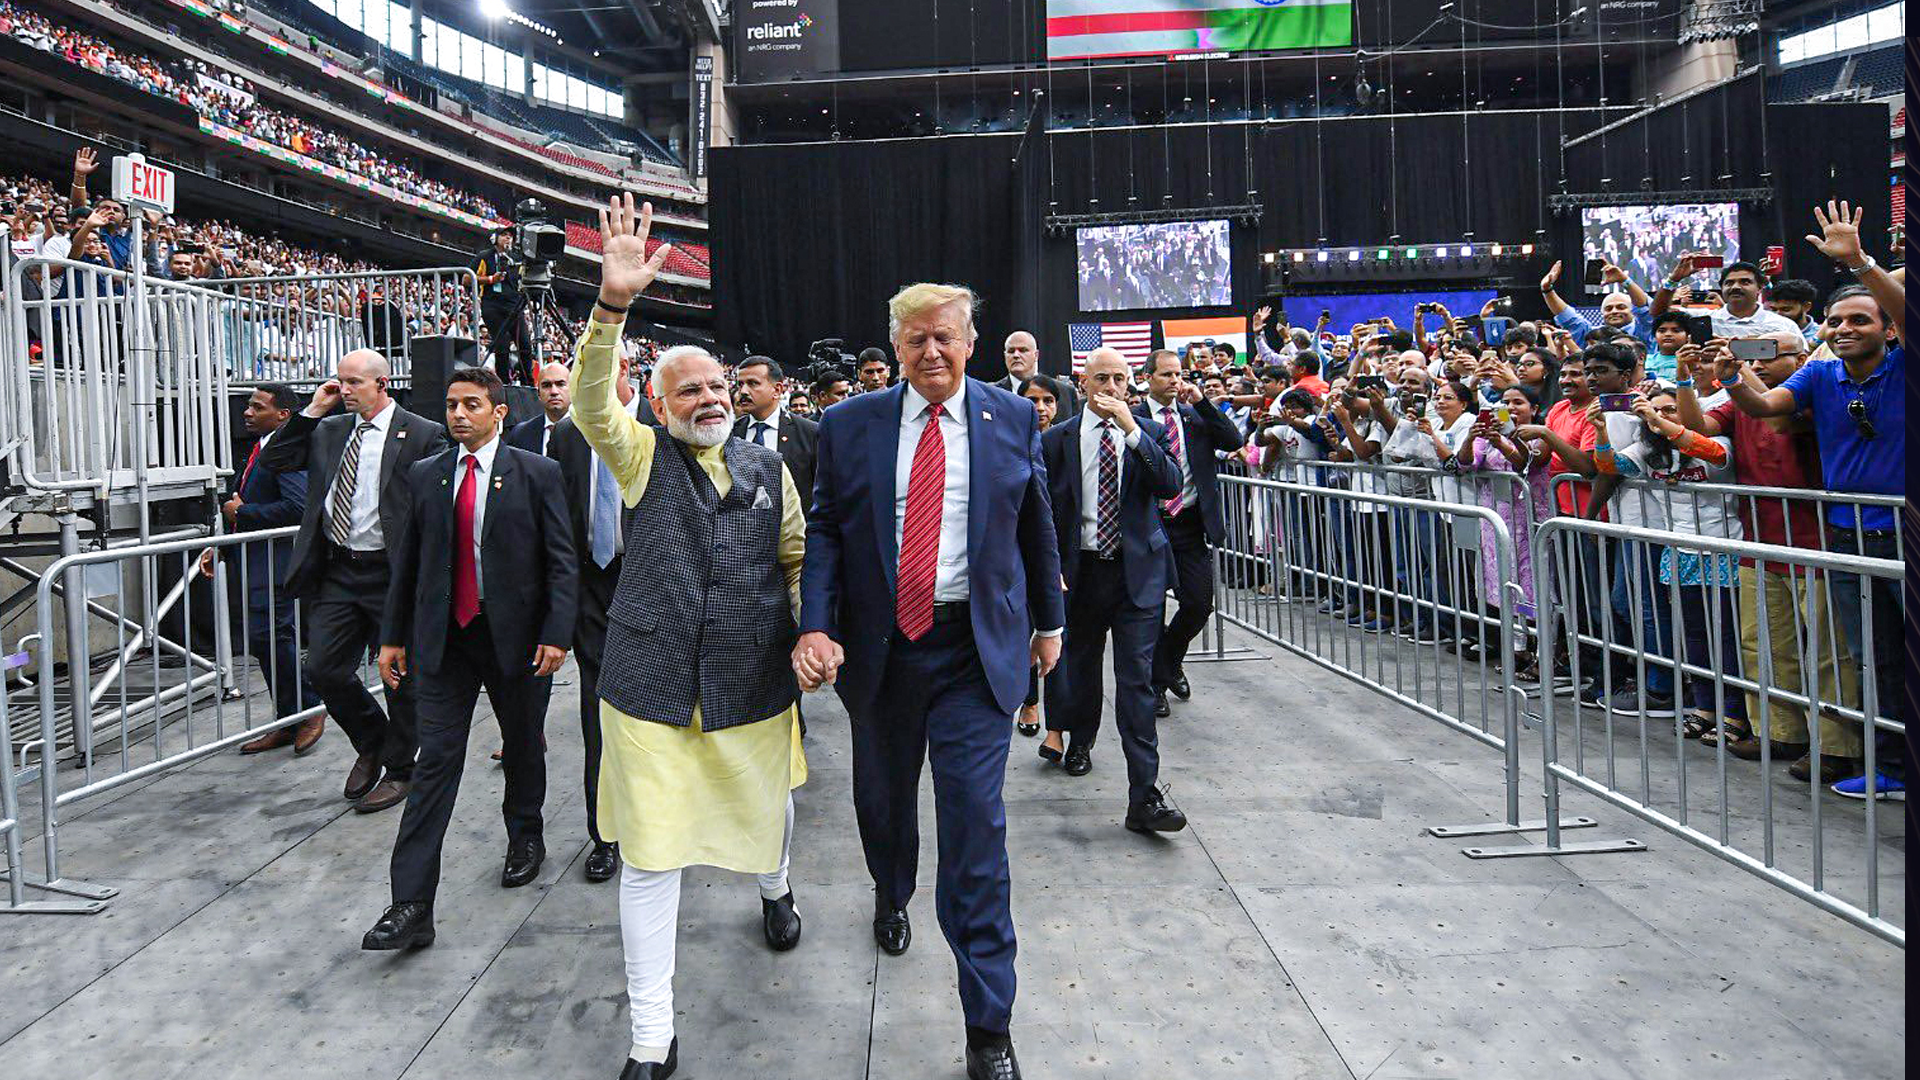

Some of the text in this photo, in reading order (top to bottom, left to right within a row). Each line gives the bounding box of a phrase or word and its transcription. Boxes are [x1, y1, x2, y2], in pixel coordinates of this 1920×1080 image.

[752, 0, 799, 9] powered by
[747, 22, 802, 39] reliant
[132, 162, 167, 202] EXIT
